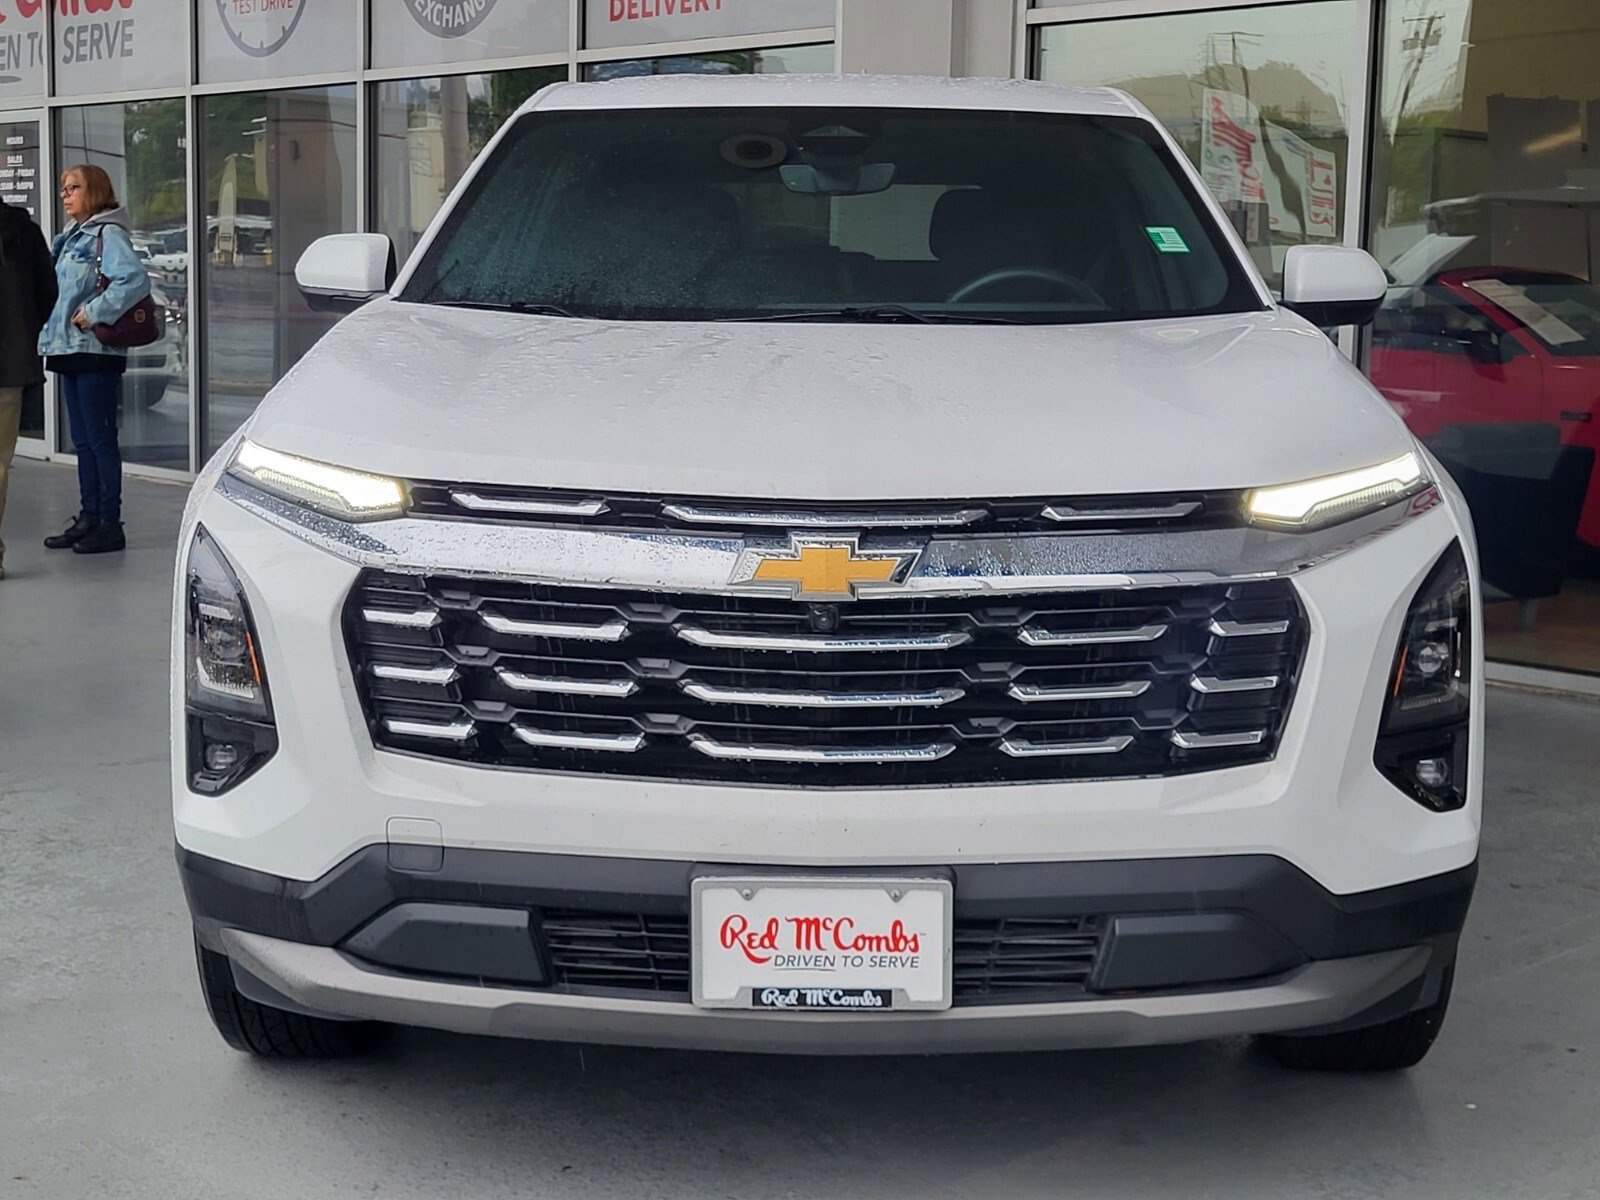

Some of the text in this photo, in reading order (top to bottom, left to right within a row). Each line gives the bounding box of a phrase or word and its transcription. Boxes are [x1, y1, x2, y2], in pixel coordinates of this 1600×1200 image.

[232, 0, 256, 15] TEST
[27, 31, 44, 67] T
[62, 19, 134, 64] SERVE
[720, 914, 919, 964] Red McCombs
[774, 954, 920, 969] DRIVEN TO SERVE
[760, 988, 883, 1008] Red McCombs
